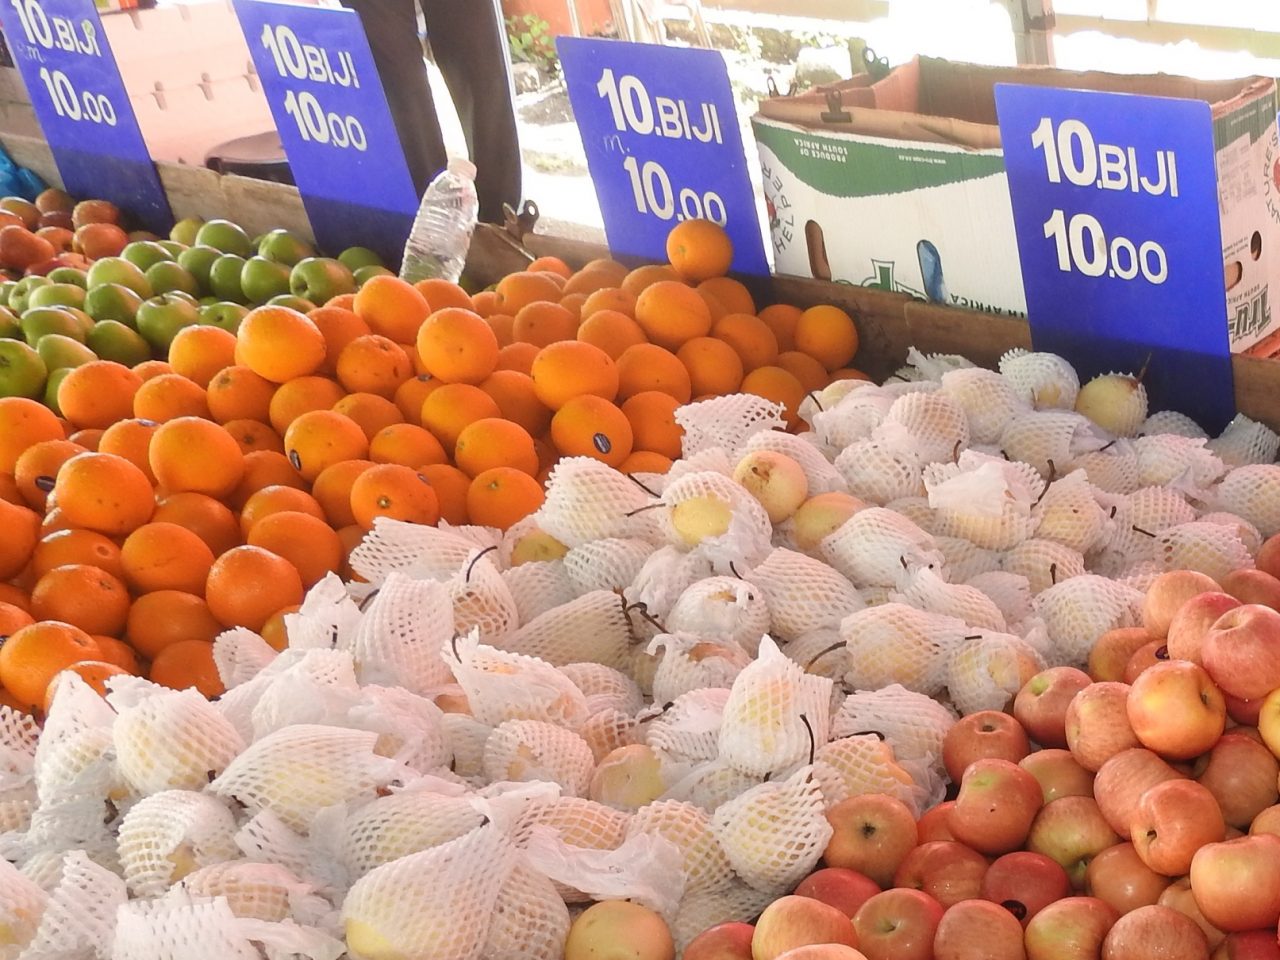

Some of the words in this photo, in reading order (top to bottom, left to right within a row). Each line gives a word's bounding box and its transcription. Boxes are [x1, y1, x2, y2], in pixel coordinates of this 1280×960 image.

[40, 66, 117, 127] 10.00
[284, 90, 368, 152] 10.00
[597, 68, 723, 145] 10.BIJI
[793, 138, 822, 152] AFRICA
[810, 151, 847, 163] PRODUCE
[822, 145, 849, 155] SOUTH
[1031, 117, 1179, 198] 10.BIJI
[623, 156, 727, 228] 10.00
[761, 161, 795, 254] HELPER
[1044, 209, 1169, 284] 10.00
